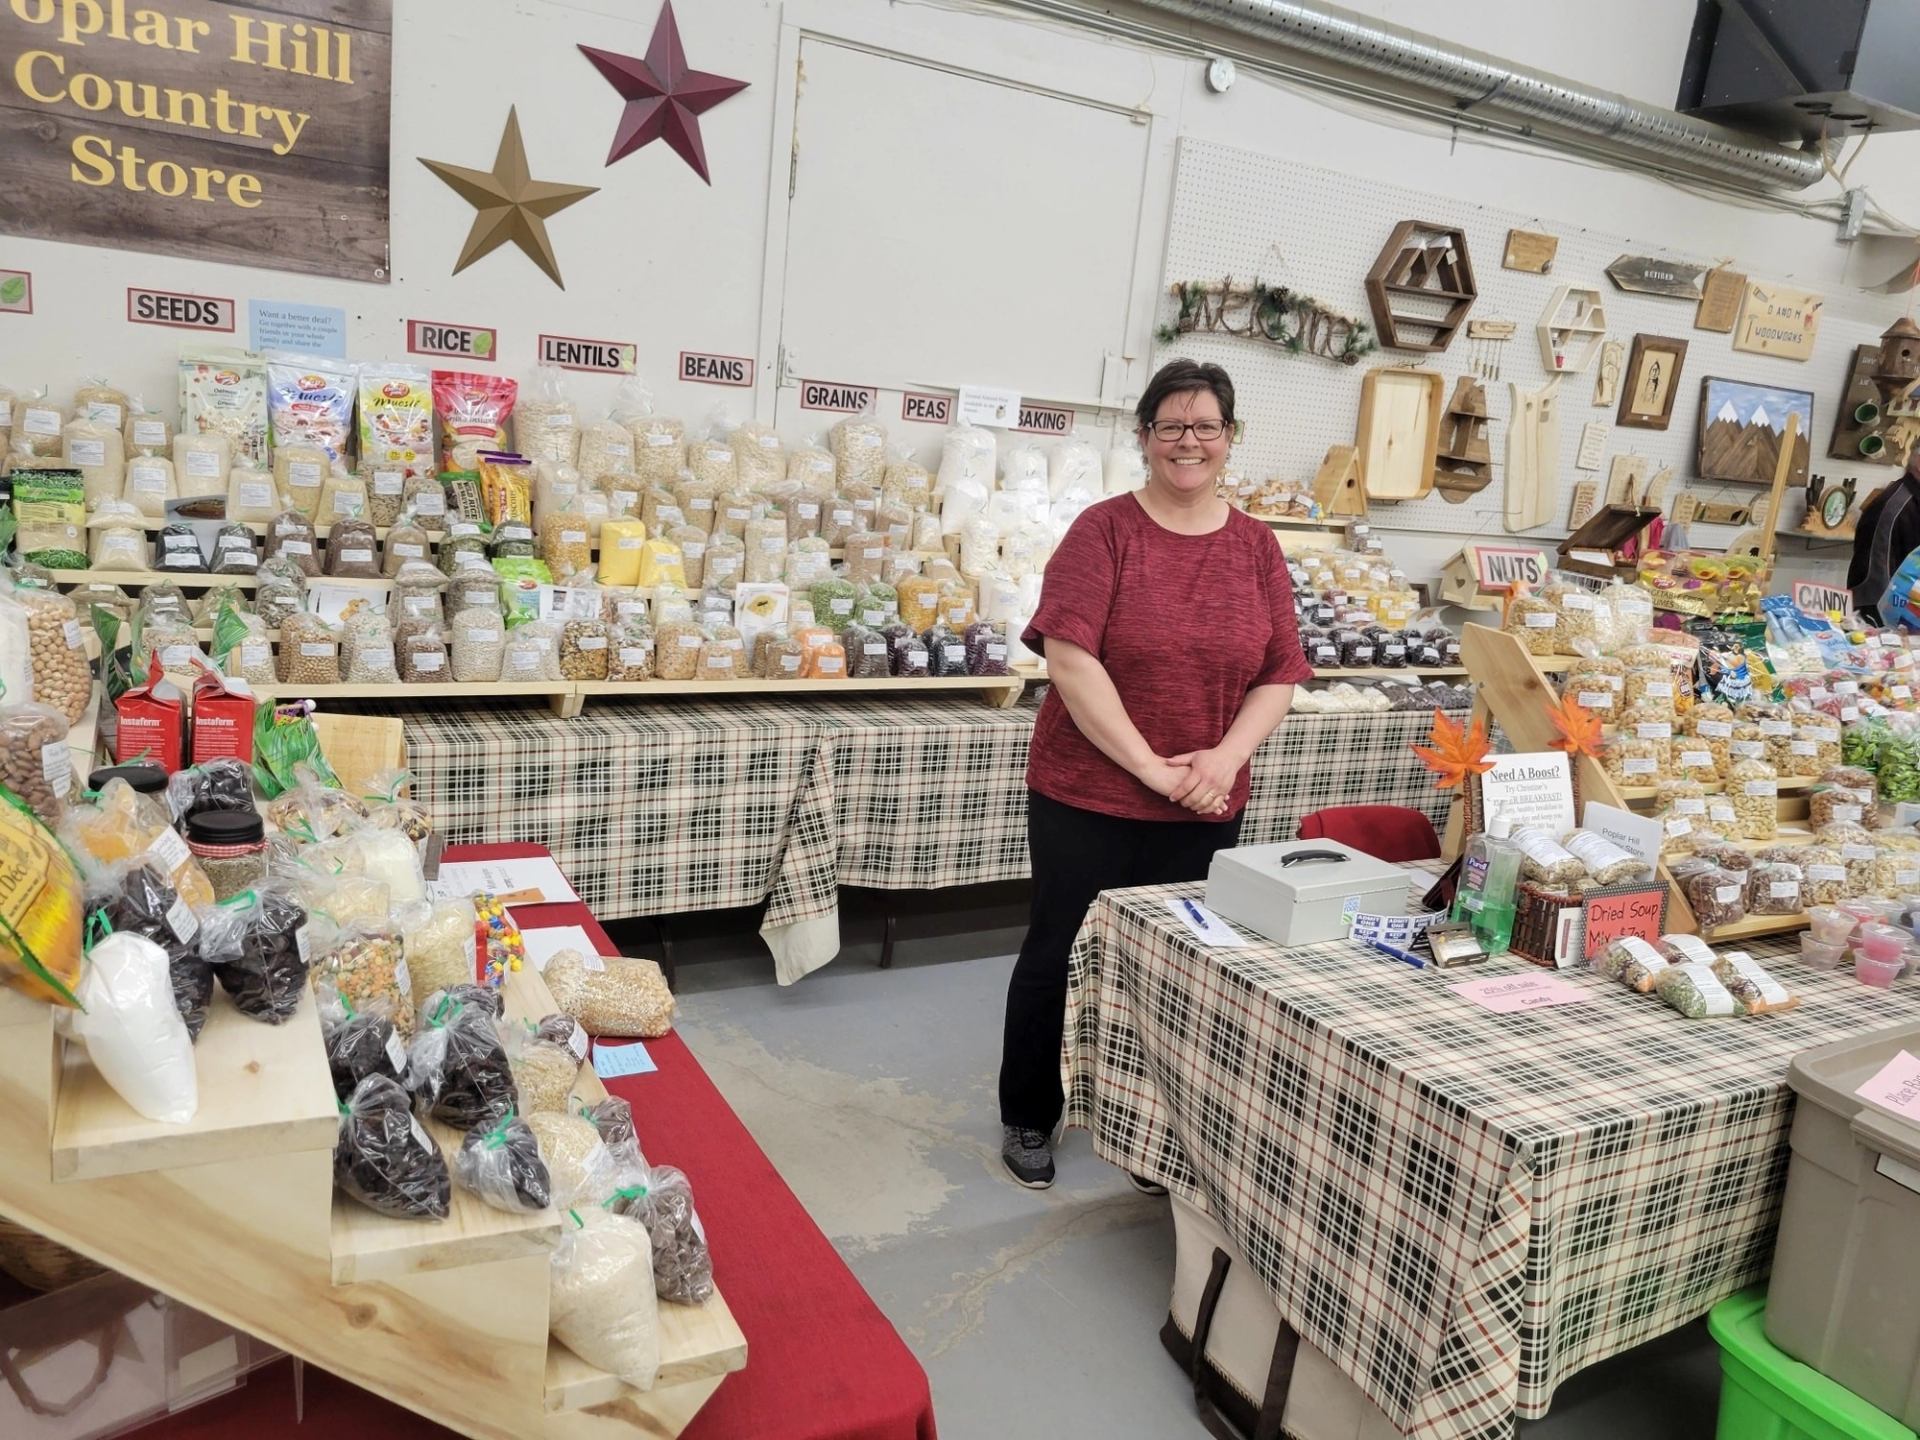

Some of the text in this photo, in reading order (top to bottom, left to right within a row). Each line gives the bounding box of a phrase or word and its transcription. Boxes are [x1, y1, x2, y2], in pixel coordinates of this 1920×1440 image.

[11, 0, 354, 84] oplar Hill
[14, 50, 310, 156] Country
[71, 134, 263, 209] Store
[137, 294, 219, 325] SEEDS
[1775, 308, 1792, 319] AND
[422, 327, 471, 353] RICE
[1755, 326, 1803, 344] WOODWORKS
[546, 341, 620, 368] LENTILS
[685, 356, 744, 382] BEANS
[806, 385, 868, 409] GRAINS
[907, 398, 946, 419] PEAS
[1488, 555, 1540, 584] NUTS
[1798, 585, 1848, 616] CANDY
[1490, 765, 1561, 783] Need A Boost?
[1602, 827, 1626, 841] Poplar
[1627, 836, 1641, 845] Hill
[1591, 901, 1659, 922] Dried Soup
